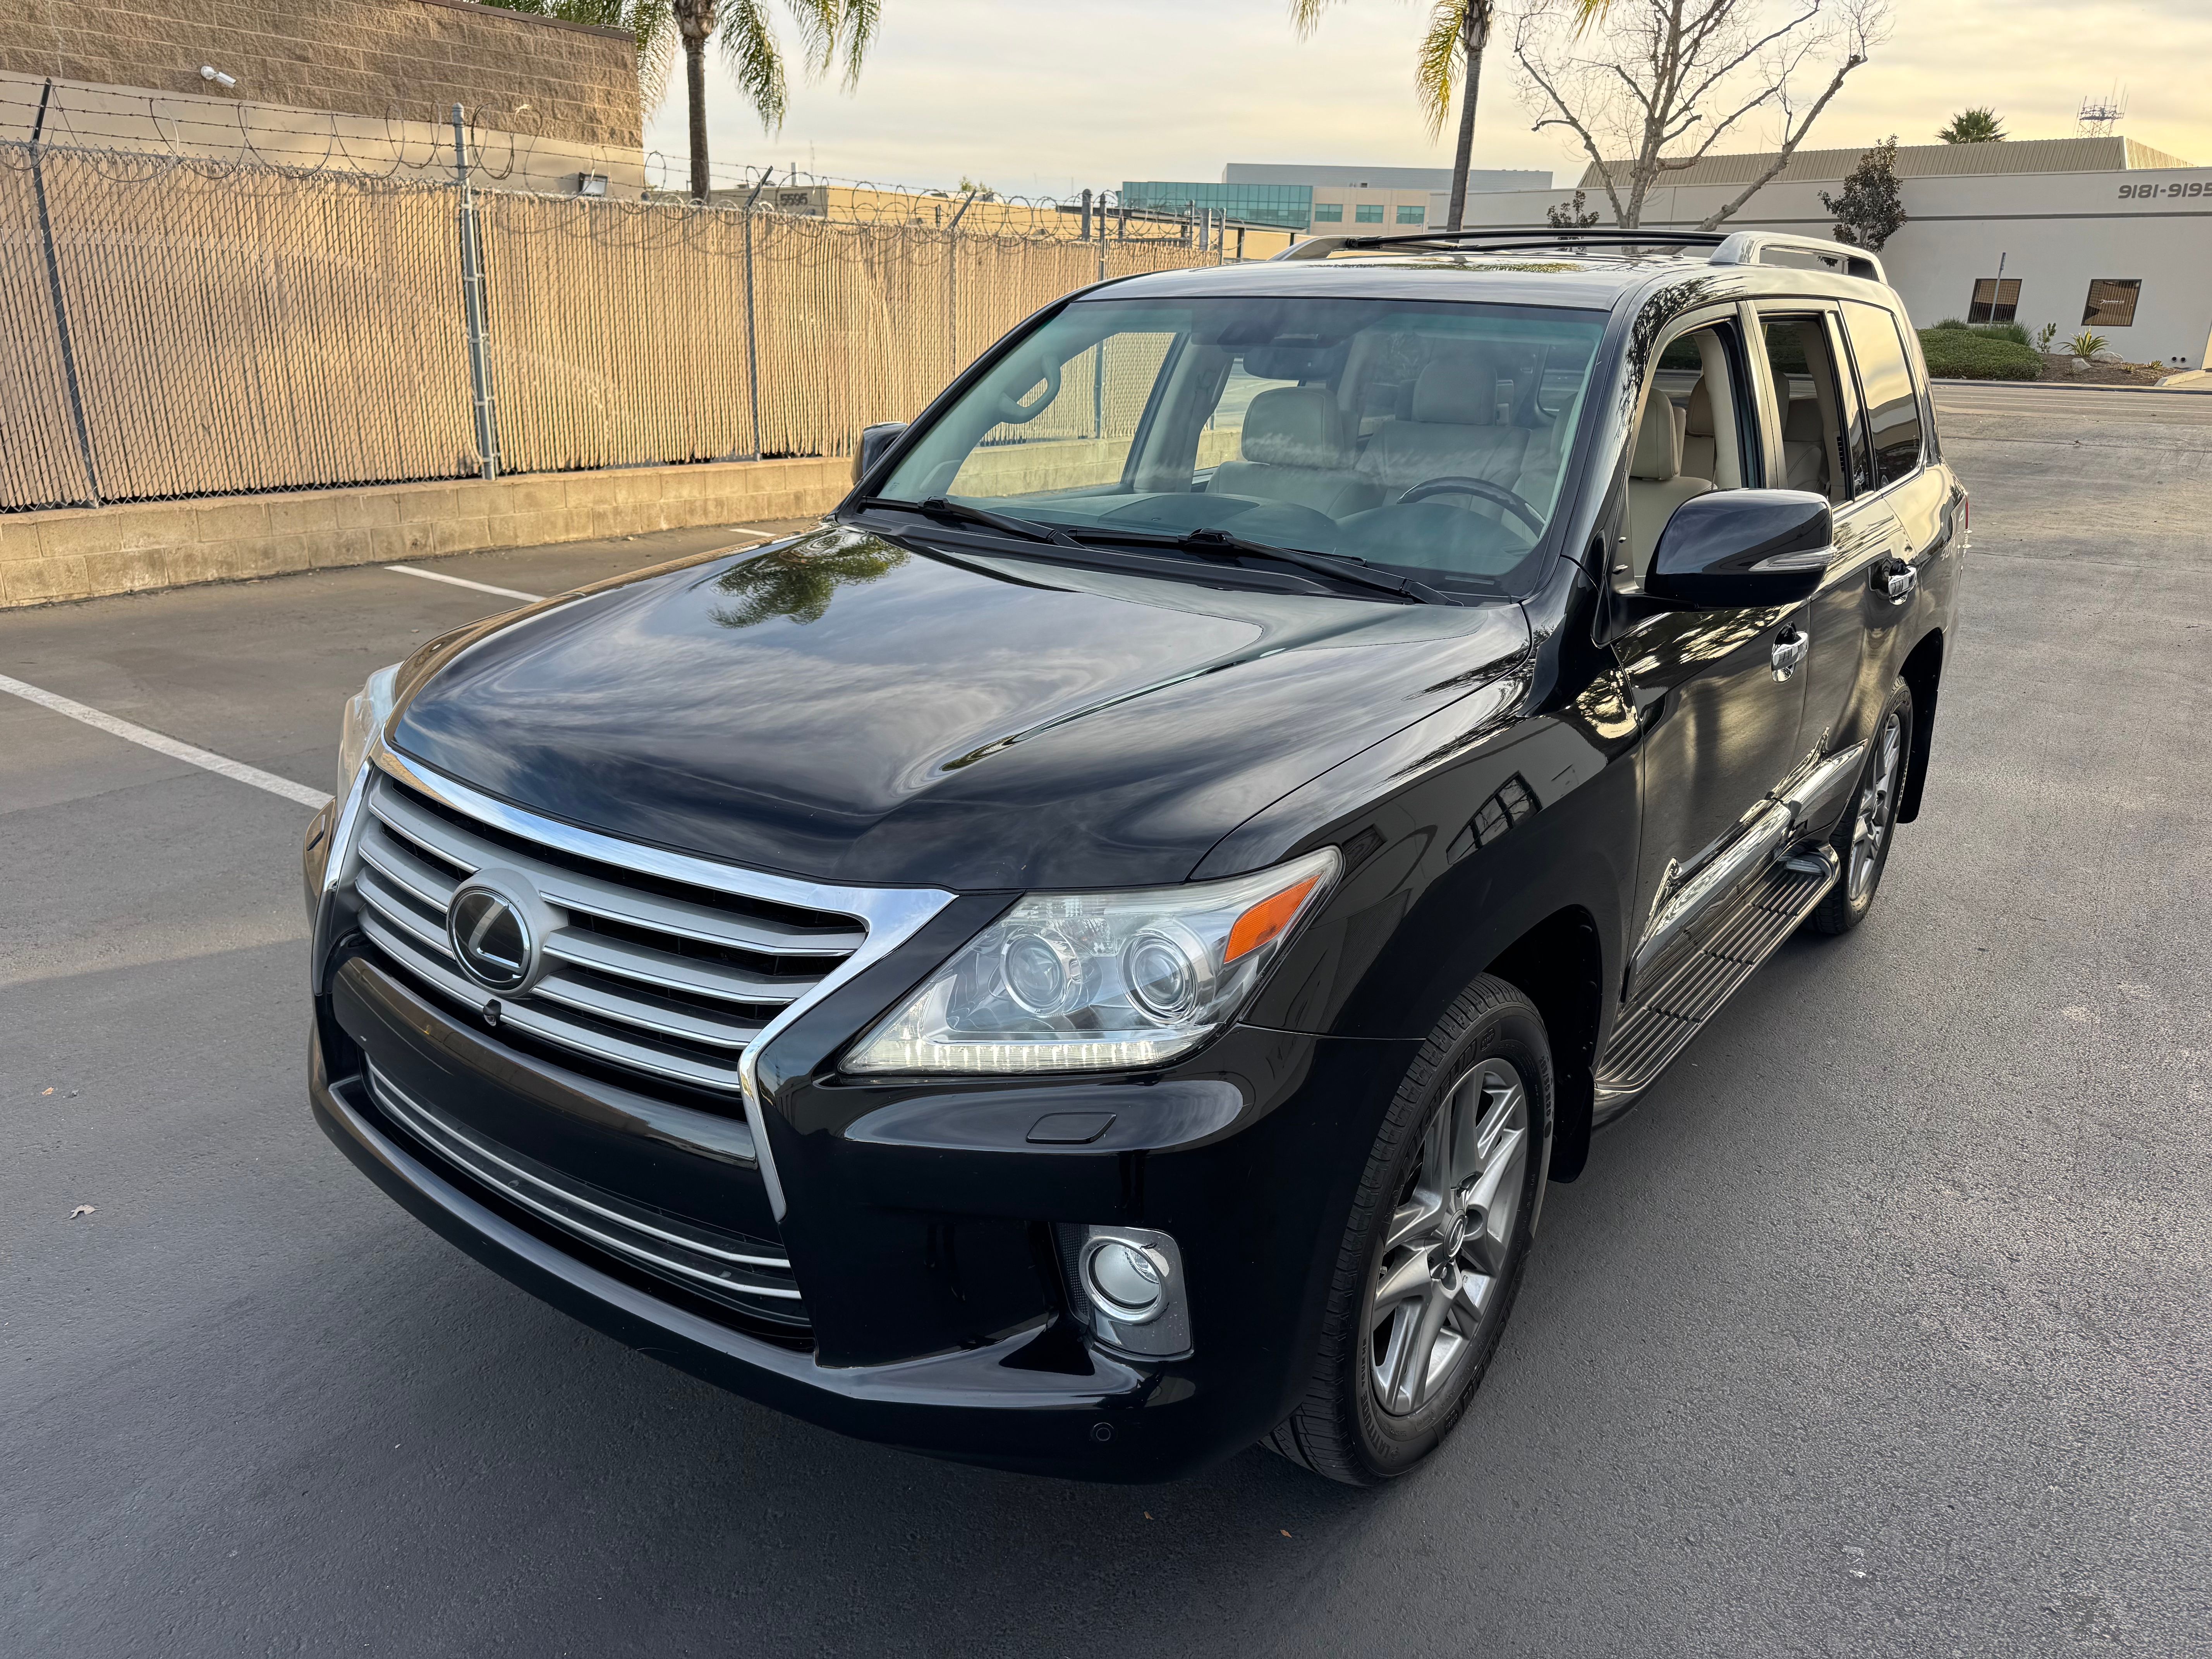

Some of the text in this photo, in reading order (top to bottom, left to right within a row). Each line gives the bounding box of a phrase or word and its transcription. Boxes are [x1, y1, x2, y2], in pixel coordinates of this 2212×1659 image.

[2118, 182, 2212, 198] 9181-9195
[780, 193, 808, 206] 5595
[1360, 1390, 1391, 1459] LATITUDE
